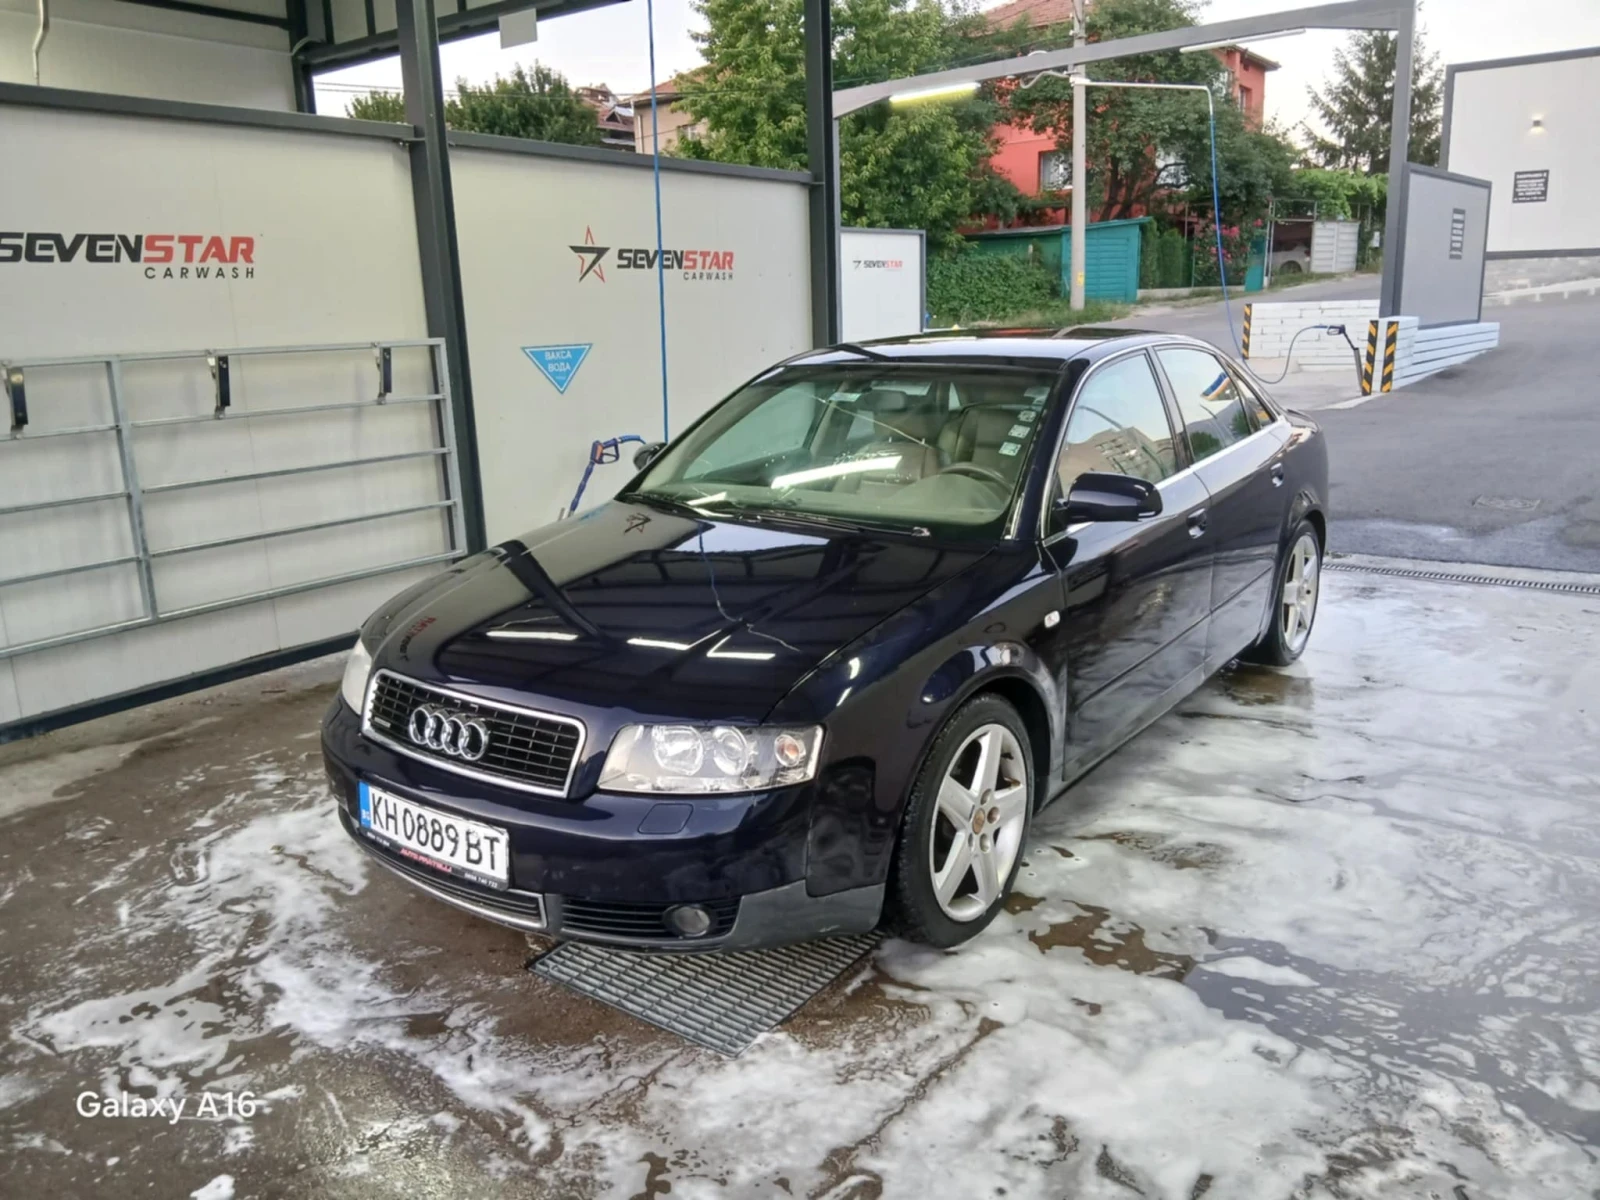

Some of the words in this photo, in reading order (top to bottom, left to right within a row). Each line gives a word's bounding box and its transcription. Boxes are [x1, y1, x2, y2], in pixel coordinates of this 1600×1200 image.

[0, 232, 254, 263] SEVENSTAR
[616, 248, 734, 270] SEVENSTAR
[144, 267, 254, 279] CARWASH
[683, 272, 733, 281] CARWASH
[544, 350, 572, 360] ВАКСА
[547, 362, 571, 372] ВОДА
